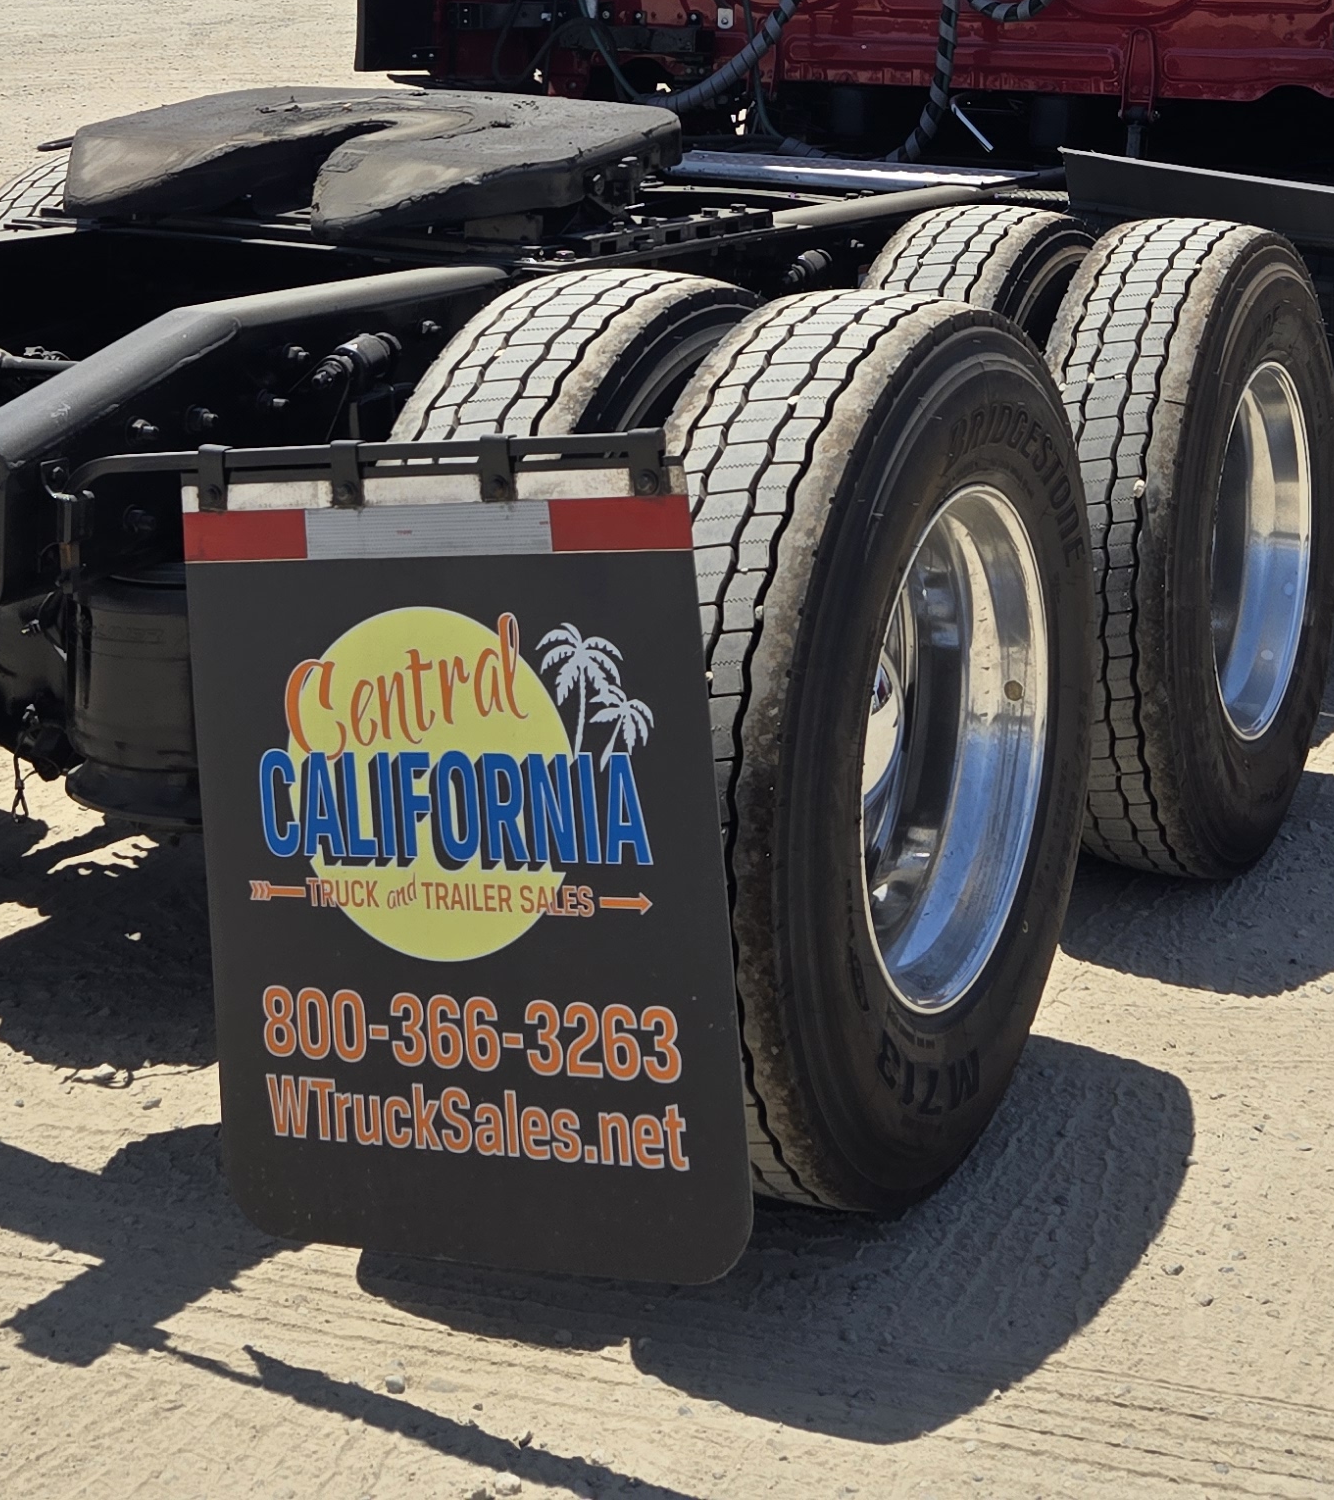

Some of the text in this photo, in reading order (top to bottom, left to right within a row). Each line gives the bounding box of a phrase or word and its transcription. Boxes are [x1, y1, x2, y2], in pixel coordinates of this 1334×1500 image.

[941, 401, 1085, 568] BRIDGESTONE
[284, 612, 529, 761] Central
[259, 746, 654, 869] CALIFORNIA
[306, 871, 595, 918] TRUCK and TRAILER SALES
[262, 985, 683, 1084] 800-366-3263
[876, 1029, 980, 1117] M713
[265, 1072, 691, 1172] WTruckSales.net
